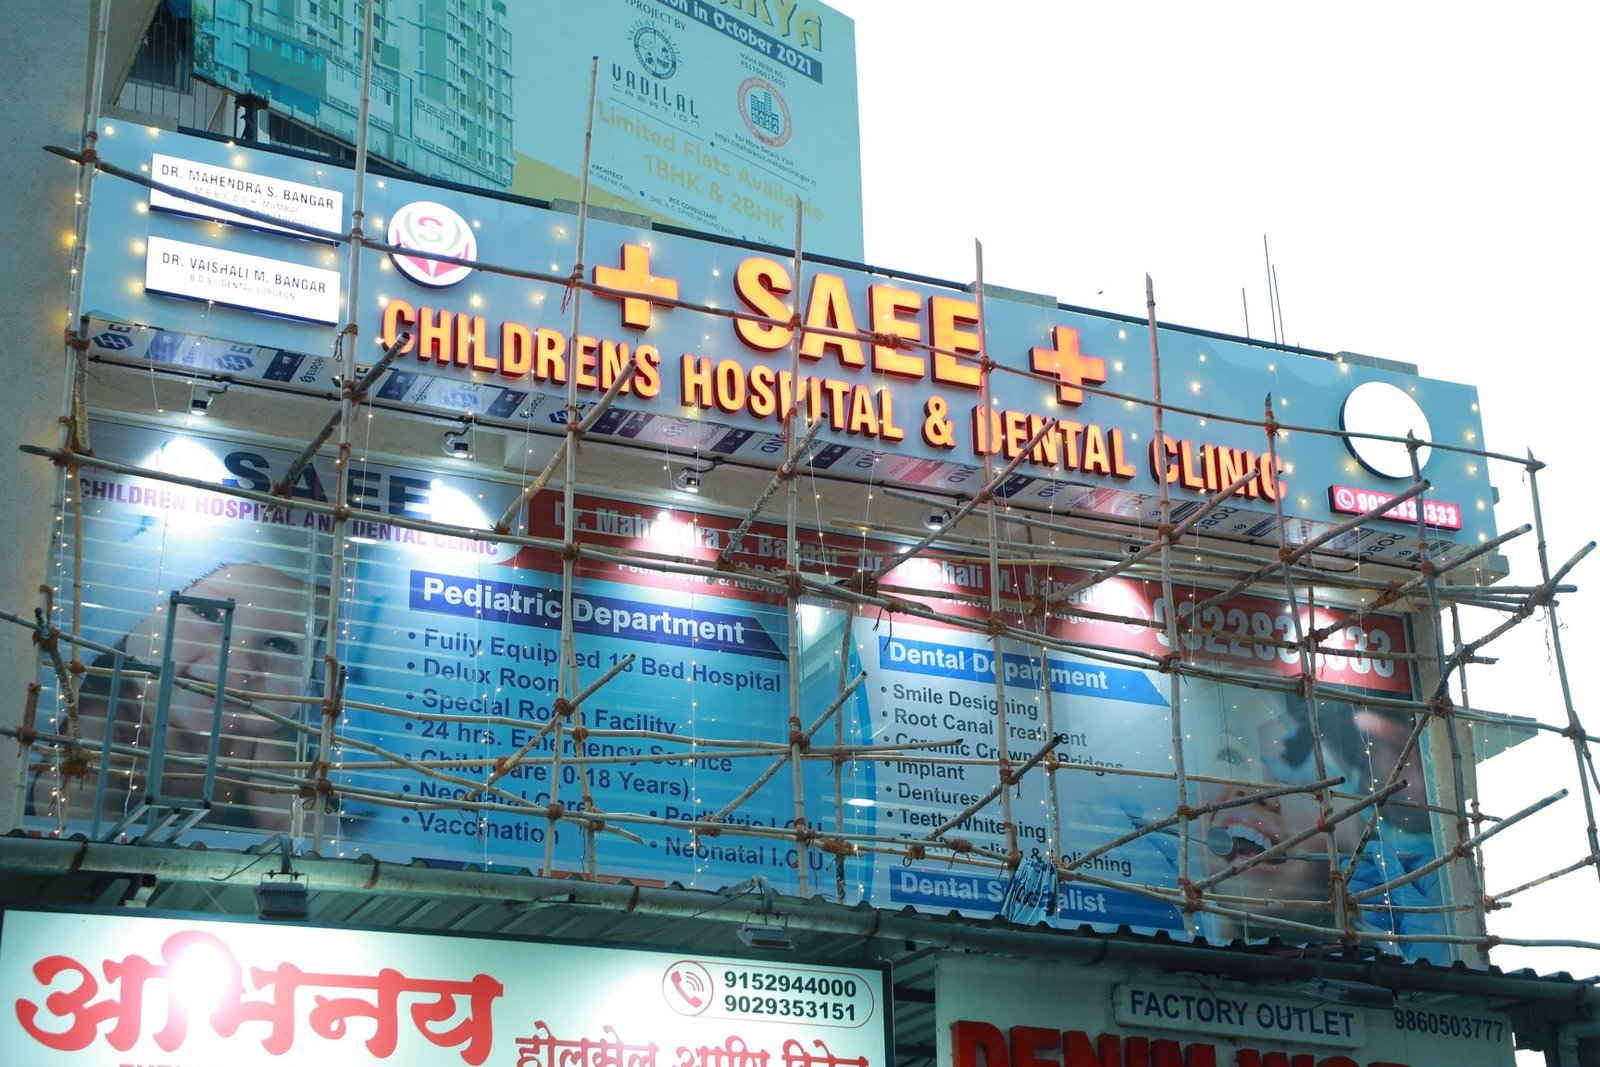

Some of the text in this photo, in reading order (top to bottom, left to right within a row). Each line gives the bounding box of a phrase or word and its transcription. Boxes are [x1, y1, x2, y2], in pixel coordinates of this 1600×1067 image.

[674, 18, 687, 31] BY
[693, 1, 709, 23] in
[713, 12, 773, 56] October
[776, 43, 813, 70] 2021
[598, 99, 677, 153] Limited
[682, 138, 732, 178] Flats
[161, 163, 335, 210] DR. MAHENDRA S. BANGAR
[643, 153, 787, 234] 1BHK & 2BHK
[161, 252, 326, 294] DR. VAISHALI M. BANGAR
[734, 257, 982, 390] SAEE
[381, 299, 1288, 502] CHILDRENS HOSPITAL & DENTAL CLINIC
[222, 451, 432, 521] SAEE
[80, 477, 187, 511] CHILDREN
[195, 496, 297, 527] HOSPITAL
[303, 511, 337, 532] AN
[434, 531, 499, 556] CLINIC
[423, 576, 745, 645] Pediatric Department
[423, 657, 491, 684] Delux
[490, 636, 600, 669] Equiped
[641, 656, 685, 680] Bed
[692, 664, 781, 692] Hospital
[889, 641, 965, 671] Dental
[421, 688, 510, 717] Special
[595, 707, 677, 735] Facility
[893, 683, 1038, 720] Smile Designing
[420, 720, 450, 740] 24
[457, 723, 502, 746] hrs.
[894, 707, 938, 729] Root
[943, 713, 993, 735] Canal
[618, 770, 690, 801] Years)
[896, 759, 965, 781] Implant
[897, 782, 980, 806] Dentures
[418, 811, 560, 845] Vaccination
[898, 808, 949, 828] Teeth
[665, 836, 764, 865] Neonatal
[900, 871, 979, 901] Dental
[723, 970, 857, 998] 9152944000
[724, 994, 856, 1021] 9029353151
[1130, 989, 1354, 1037] FACTORY OUTLET
[1394, 1009, 1504, 1042] 9860503777
